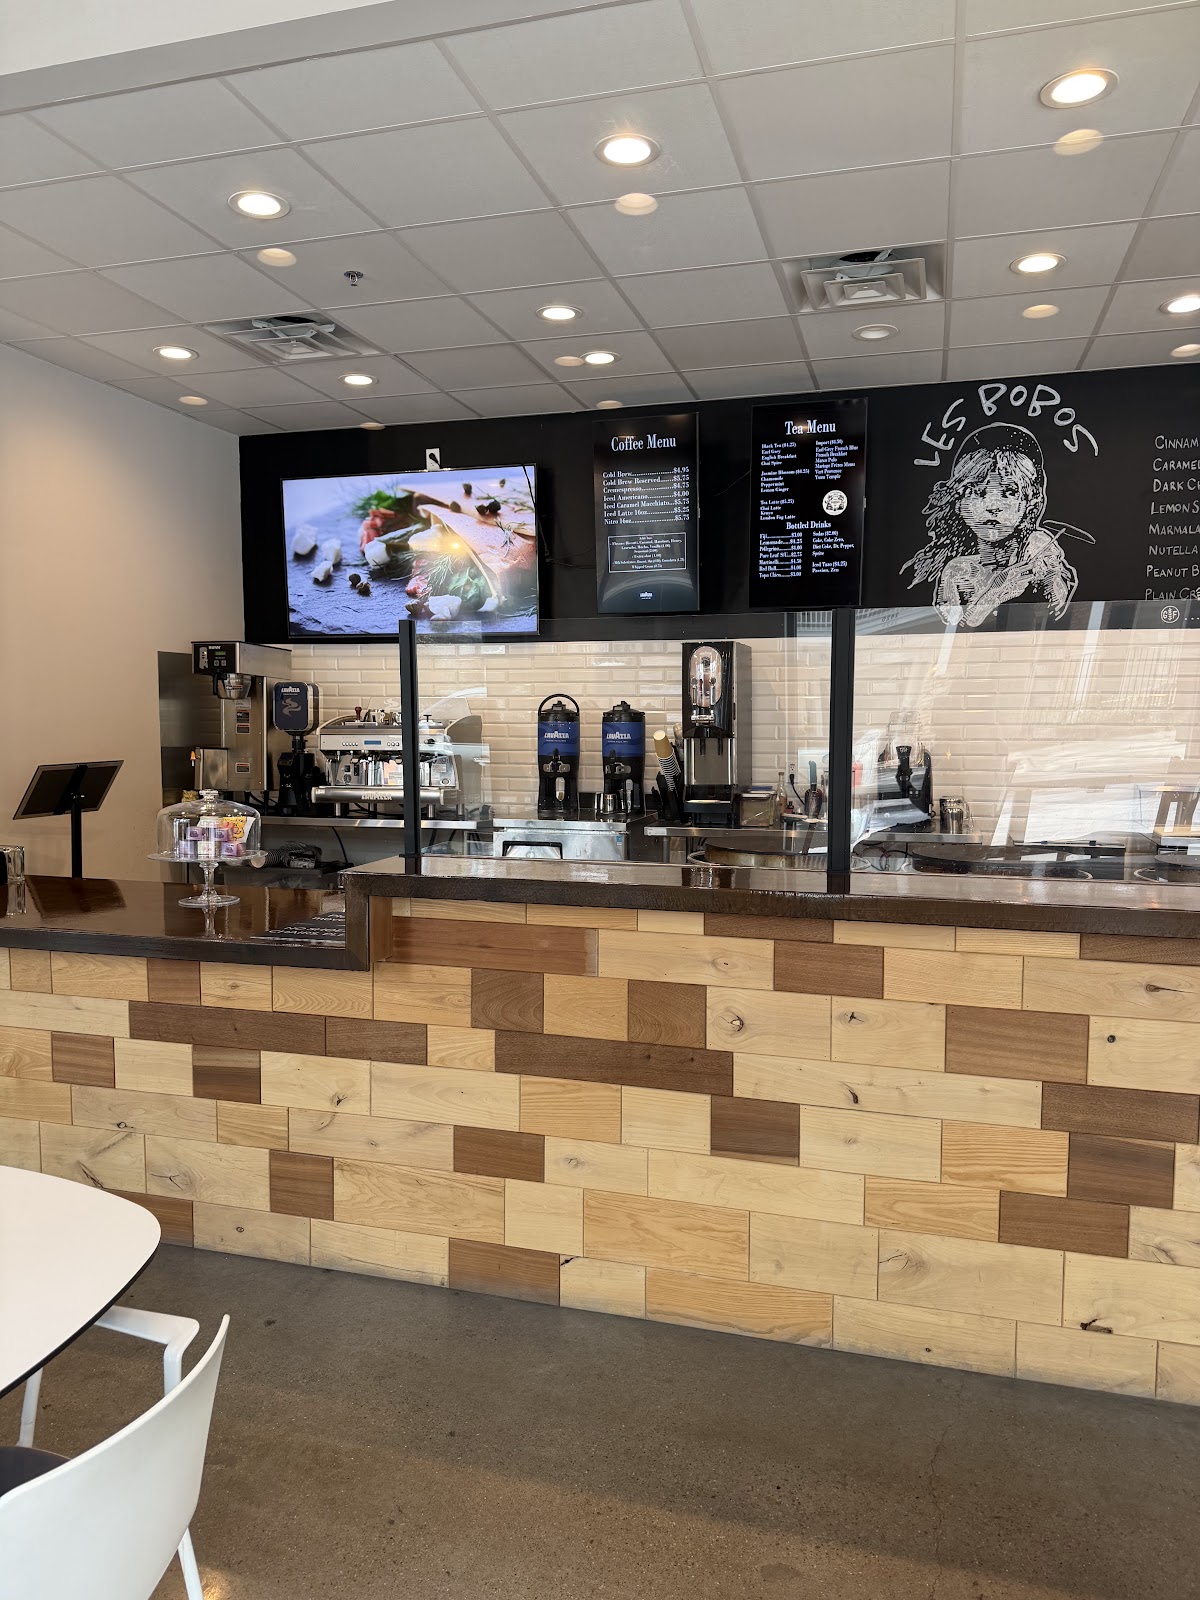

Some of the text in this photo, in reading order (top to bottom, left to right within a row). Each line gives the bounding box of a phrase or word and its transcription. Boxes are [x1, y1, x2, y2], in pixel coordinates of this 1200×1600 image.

[785, 420, 836, 435] Tea Menu
[914, 383, 1099, 467] LES BOBOS
[611, 434, 676, 451] Coffee Menu
[1155, 435, 1199, 450] CINNAM
[635, 476, 660, 484] Reserved
[1153, 479, 1184, 492] DARK
[1151, 500, 1200, 515] LEMON S
[810, 520, 831, 528] Drinks
[1149, 545, 1198, 555] NUTELLA
[1147, 564, 1200, 577] PEANUT B
[1145, 588, 1176, 600] PLAIN
